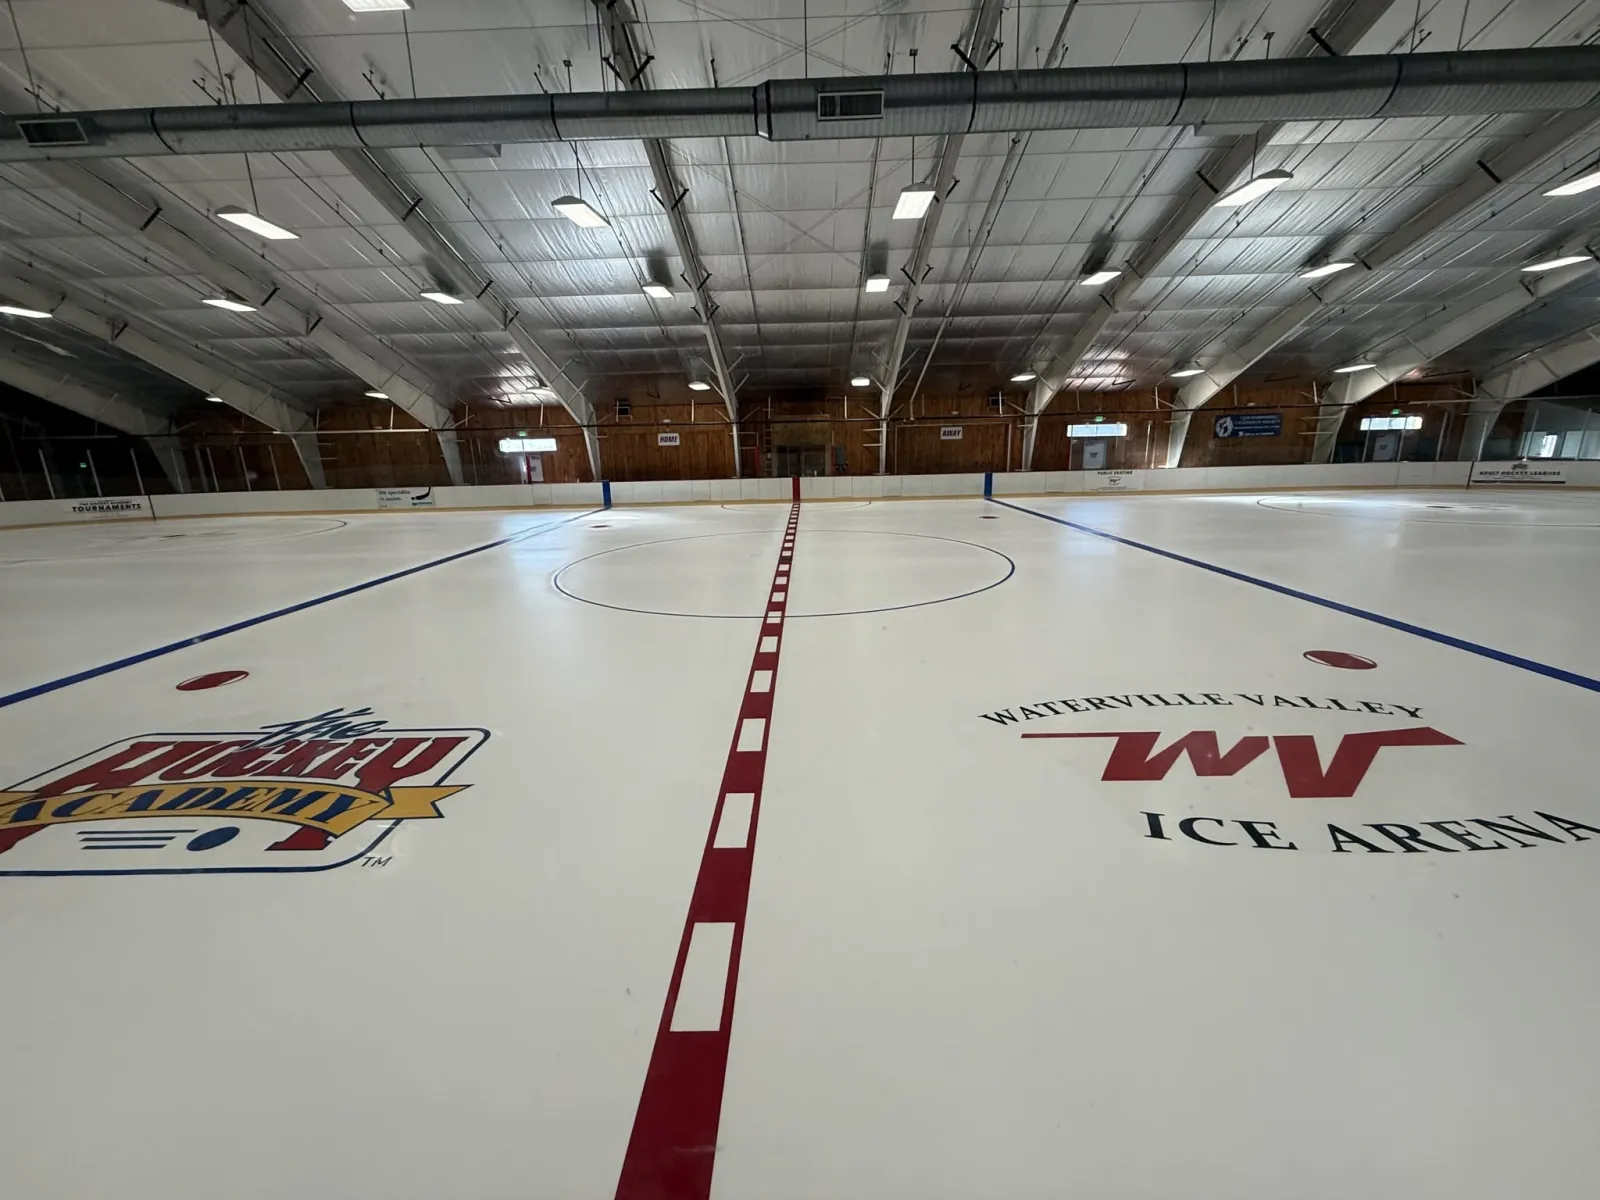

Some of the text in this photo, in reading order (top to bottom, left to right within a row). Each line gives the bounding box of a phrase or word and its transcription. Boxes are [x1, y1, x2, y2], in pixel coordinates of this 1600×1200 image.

[660, 435, 678, 443] HOME
[72, 503, 141, 512] TOURNAMENTS
[978, 693, 1424, 727] WATERVILLE VALLEY
[0, 786, 380, 824] ACADEMY
[1140, 810, 1600, 853] ICE ARENA
[362, 856, 393, 867] TM
